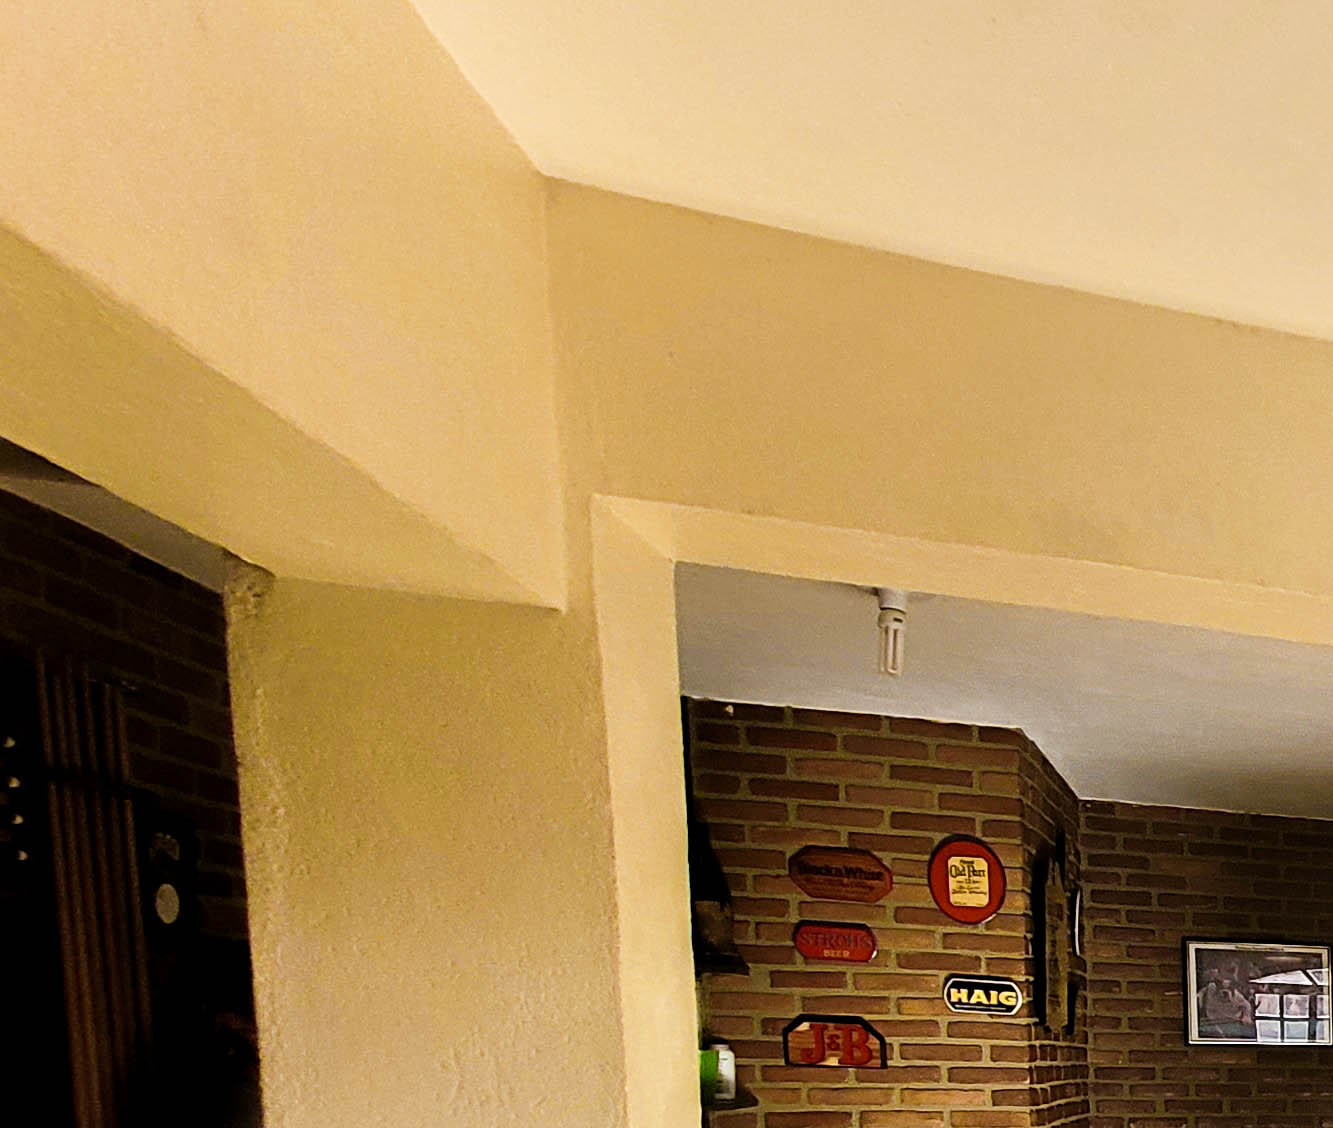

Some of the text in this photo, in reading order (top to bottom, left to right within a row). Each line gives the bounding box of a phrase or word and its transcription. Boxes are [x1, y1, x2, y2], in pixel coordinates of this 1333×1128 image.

[950, 864, 967, 878] Old
[949, 988, 1017, 1006] HAIG
[801, 1023, 873, 1065] J&B
